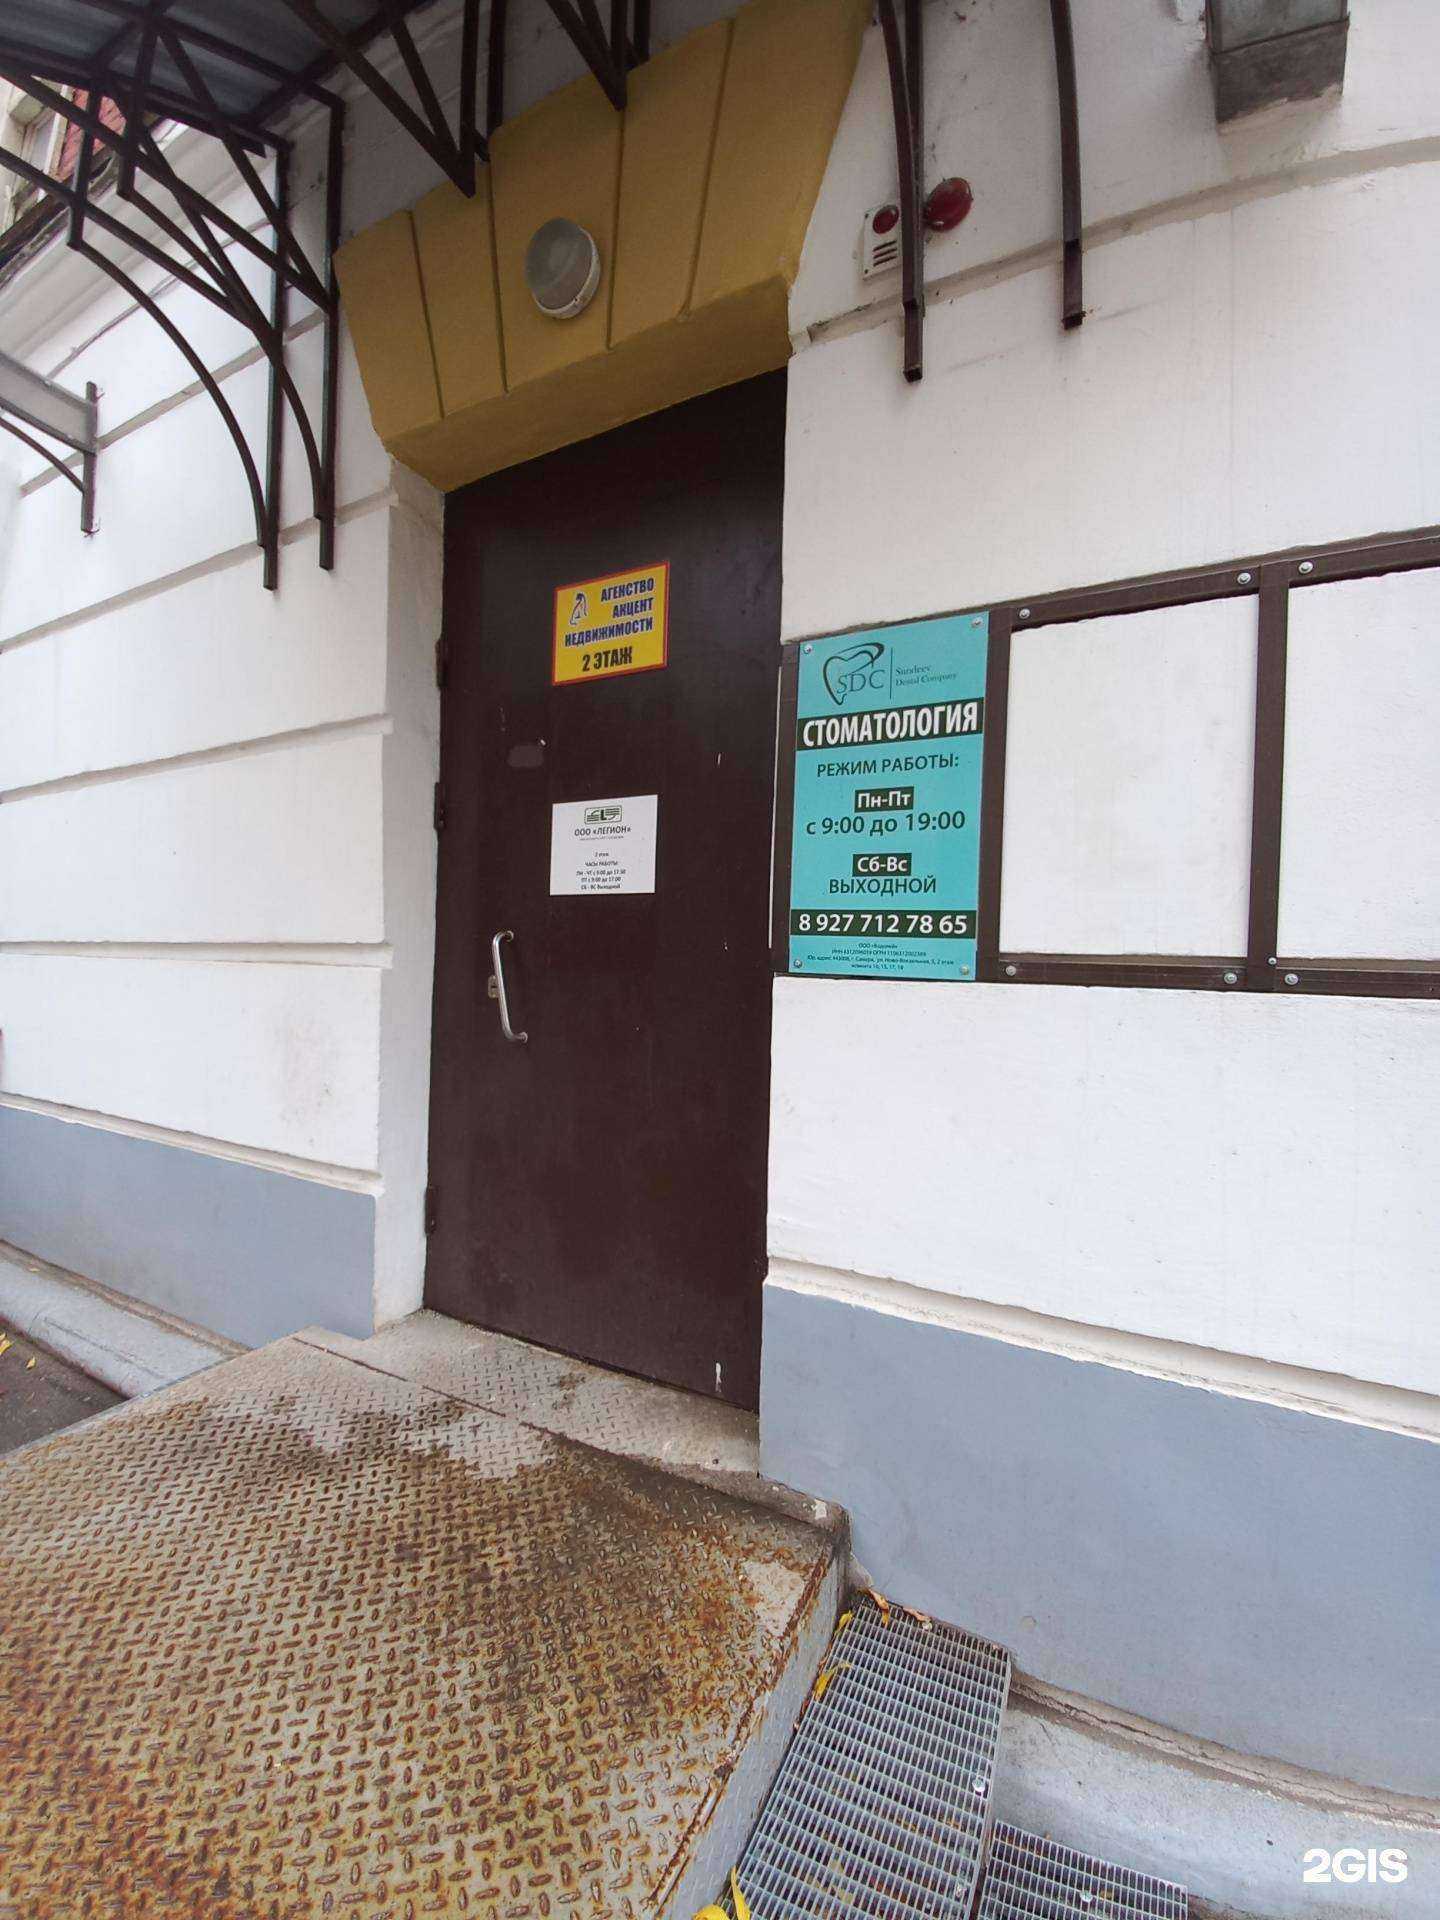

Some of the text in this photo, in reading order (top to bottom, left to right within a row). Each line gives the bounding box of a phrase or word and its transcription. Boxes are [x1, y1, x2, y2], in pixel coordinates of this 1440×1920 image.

[601, 577, 655, 602] АГЕНСТВО
[612, 597, 654, 619] АКЦЕНТ
[564, 617, 653, 647] НЕДВИЖИМОСТИ
[582, 645, 633, 672] 2 ЭТАЖ
[836, 669, 885, 694] SDC
[895, 672, 958, 687] Dental Company
[803, 702, 977, 747] СТОМАТОЛОГИЯ
[817, 753, 959, 777] РЕЖИМ РАБОТЫ:
[857, 791, 911, 808] Пн-Пт
[574, 828, 591, 836] ООО
[806, 810, 966, 836] с 9:00 до 19:00
[857, 857, 908, 873] Сб-Вс
[829, 875, 936, 897] ВЫХОДНОЙ
[799, 914, 967, 934] 8 927 712 78 65
